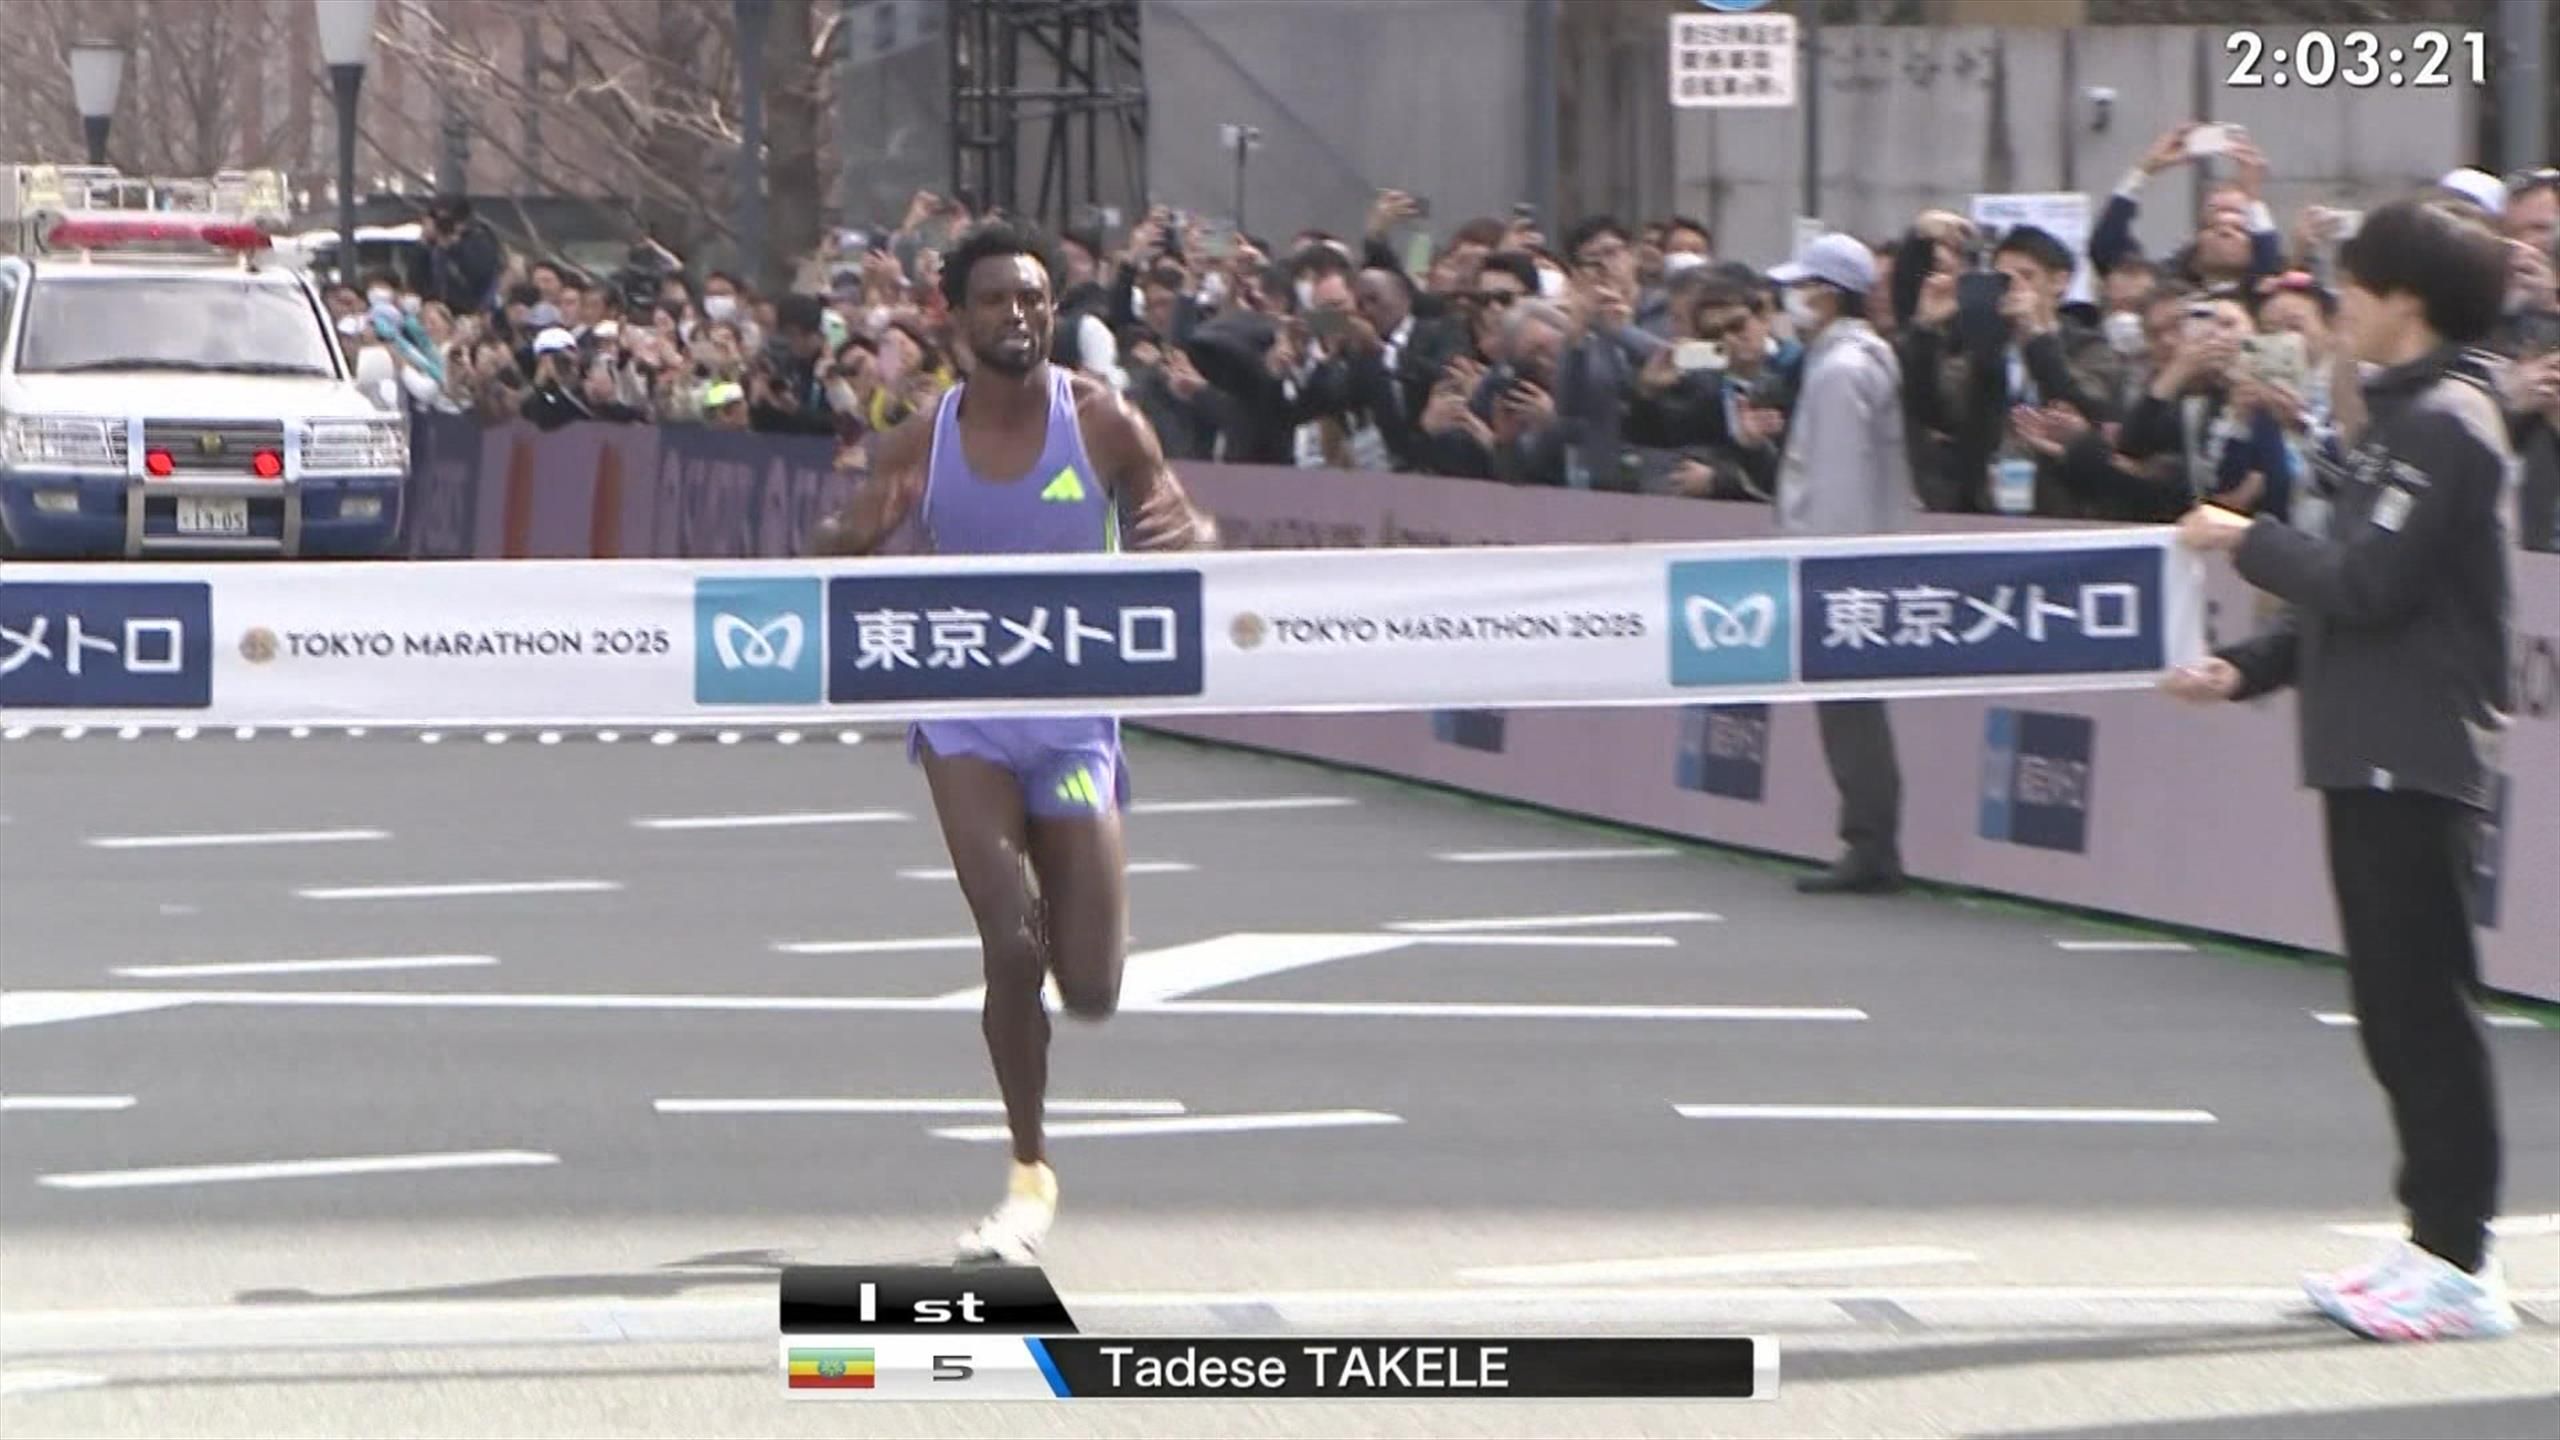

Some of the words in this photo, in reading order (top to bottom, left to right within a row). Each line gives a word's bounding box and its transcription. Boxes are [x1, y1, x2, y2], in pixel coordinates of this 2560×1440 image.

[0, 615, 183, 675] メトロ
[286, 631, 395, 658] TOKYO
[403, 630, 582, 657] MARATHON
[592, 629, 671, 655] 2025
[853, 605, 1178, 671] 東京メトロ
[1270, 615, 1378, 643] TOKYO
[1384, 612, 1558, 641] MARATHON
[1563, 611, 1648, 639] 2025
[1820, 582, 2141, 650] 東京メトロ
